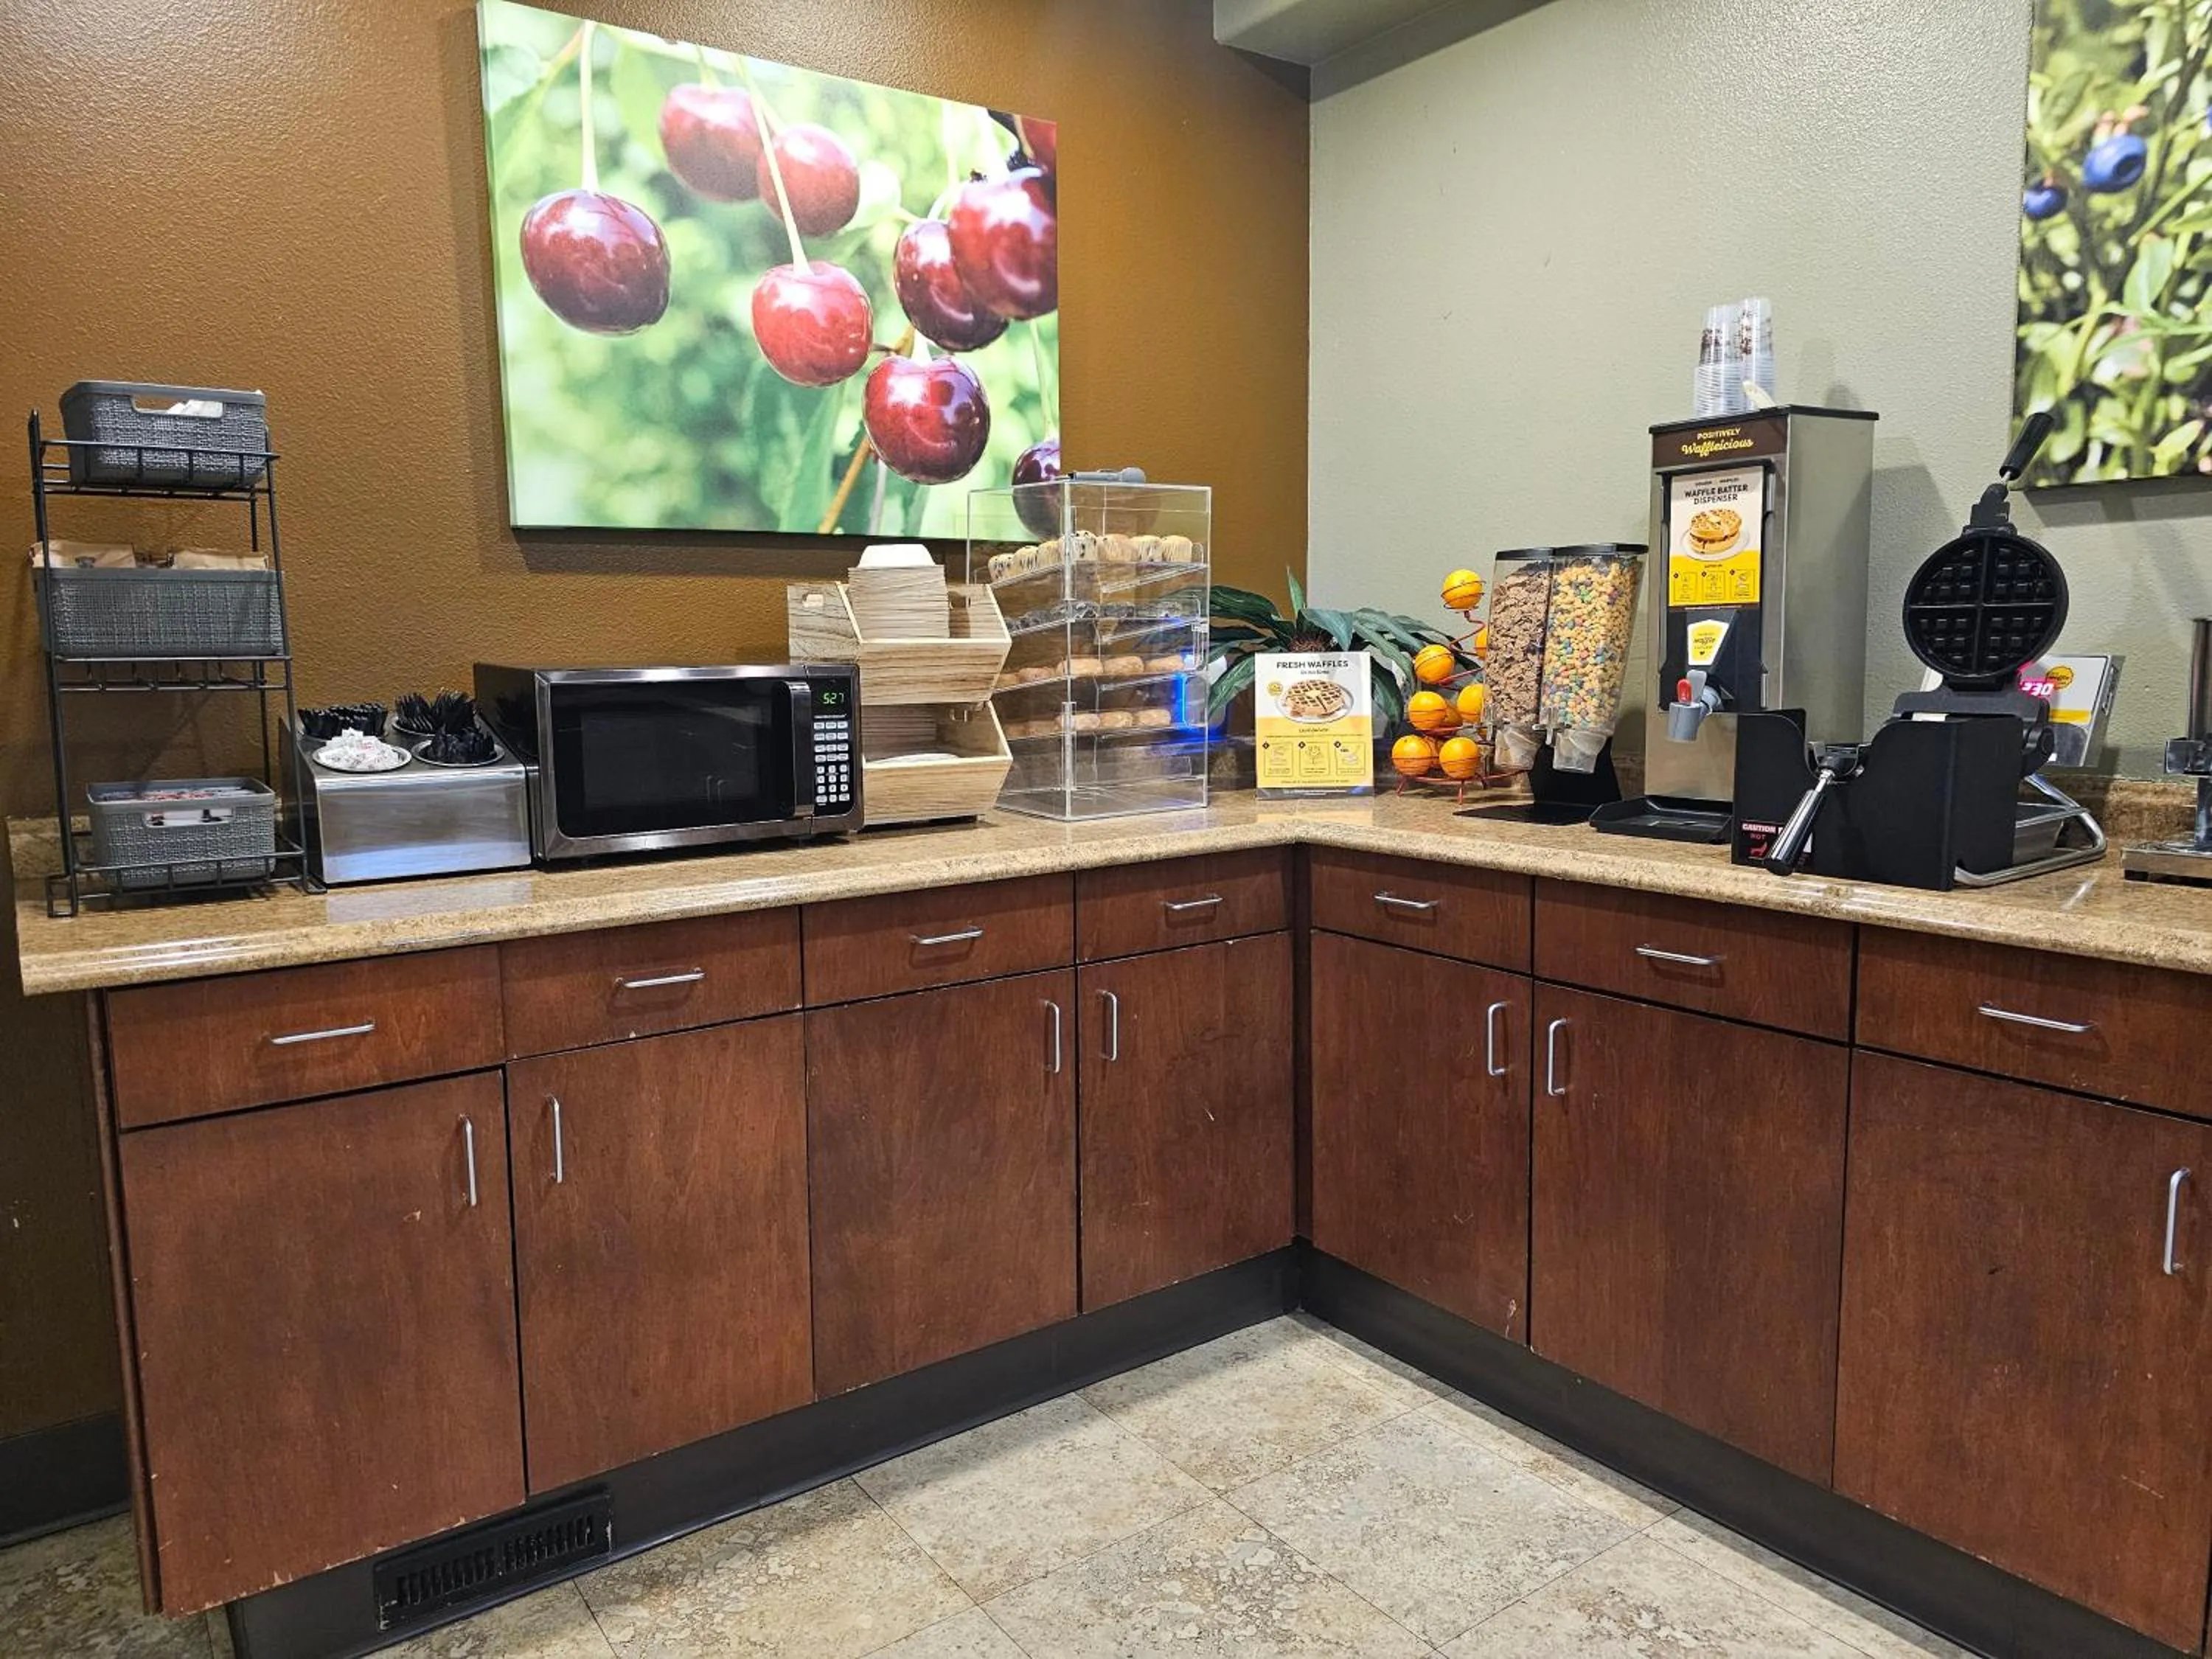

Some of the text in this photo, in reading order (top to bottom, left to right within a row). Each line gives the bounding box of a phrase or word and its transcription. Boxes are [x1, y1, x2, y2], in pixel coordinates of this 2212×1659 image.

[1697, 427, 1741, 440] POSITIVELY
[1685, 484, 1748, 498] WAFFLE BATTER
[1694, 494, 1738, 505] DISPENSER
[1307, 660, 1349, 668] WAFFLES
[1742, 824, 1776, 833] CAUTION
